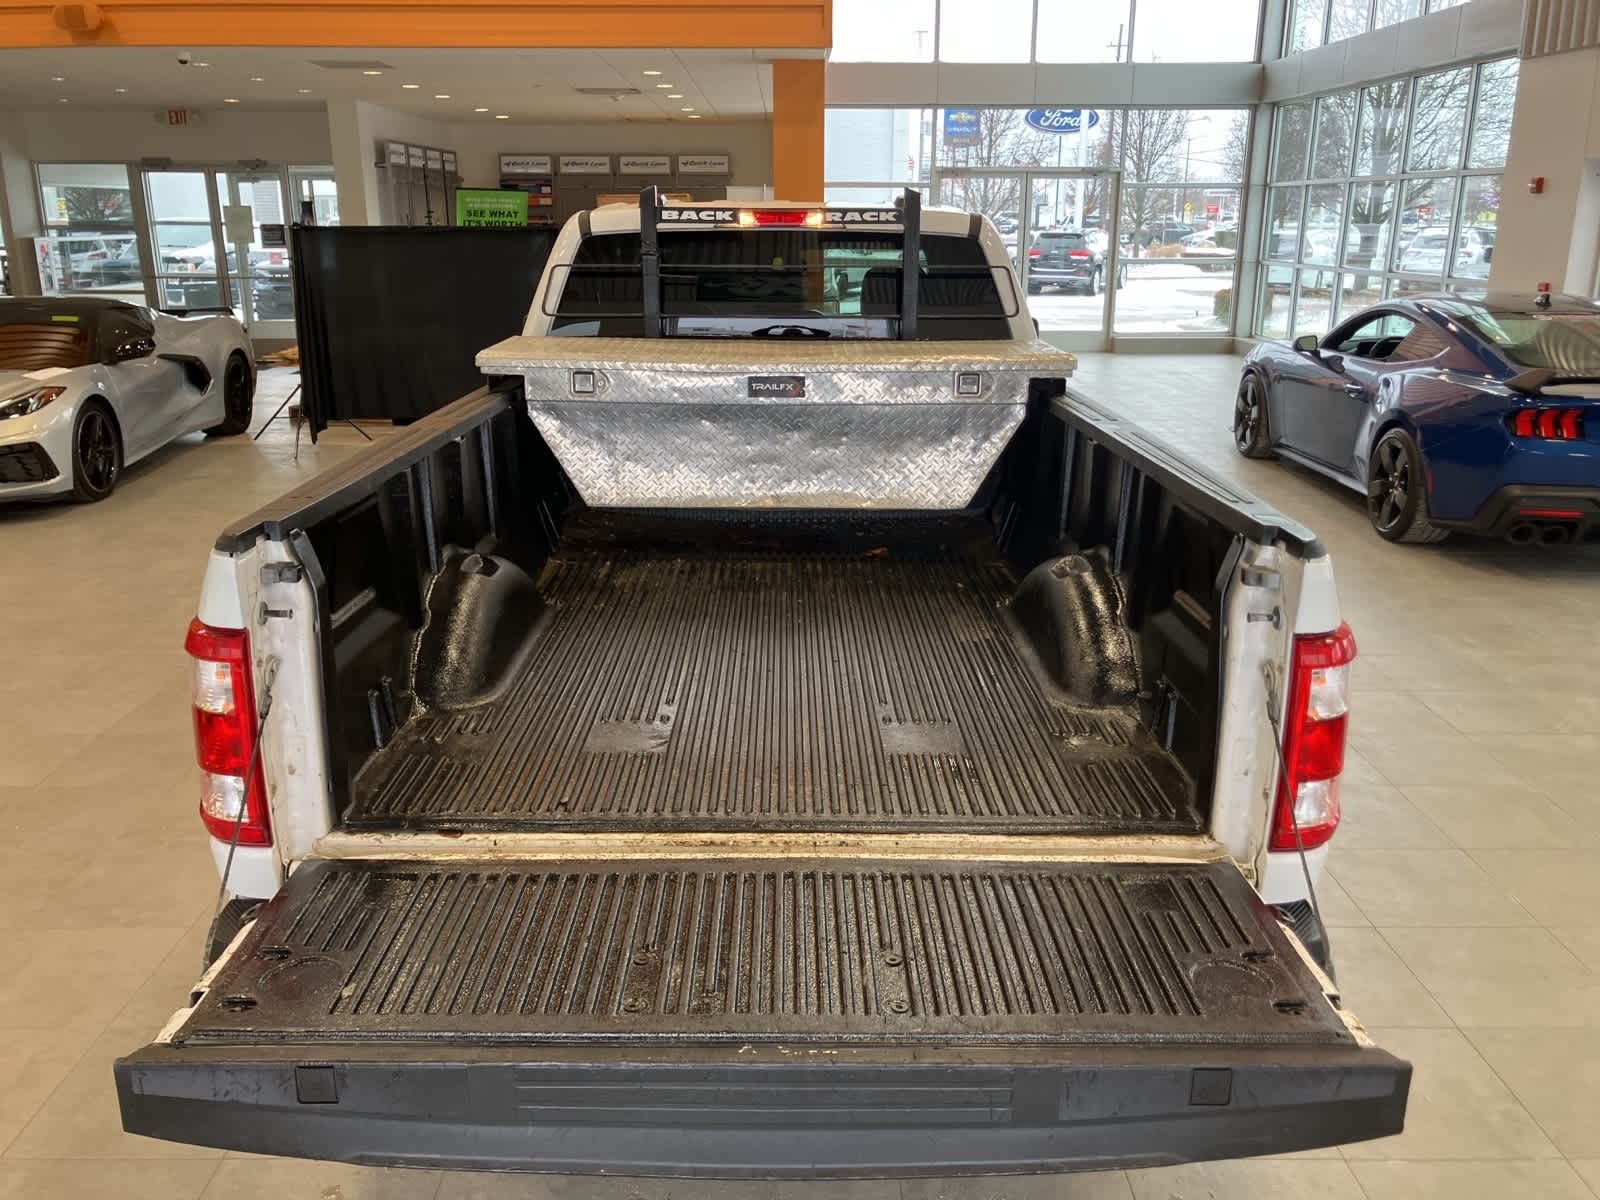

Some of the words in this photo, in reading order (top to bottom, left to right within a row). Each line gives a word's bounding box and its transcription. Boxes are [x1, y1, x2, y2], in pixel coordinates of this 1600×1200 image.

[1040, 108, 1081, 127] Ford
[466, 209, 485, 217] SEE
[489, 210, 518, 218] WHAT
[661, 210, 734, 220] BACK
[826, 211, 897, 221] RACK
[752, 383, 794, 391] TRAILFX
